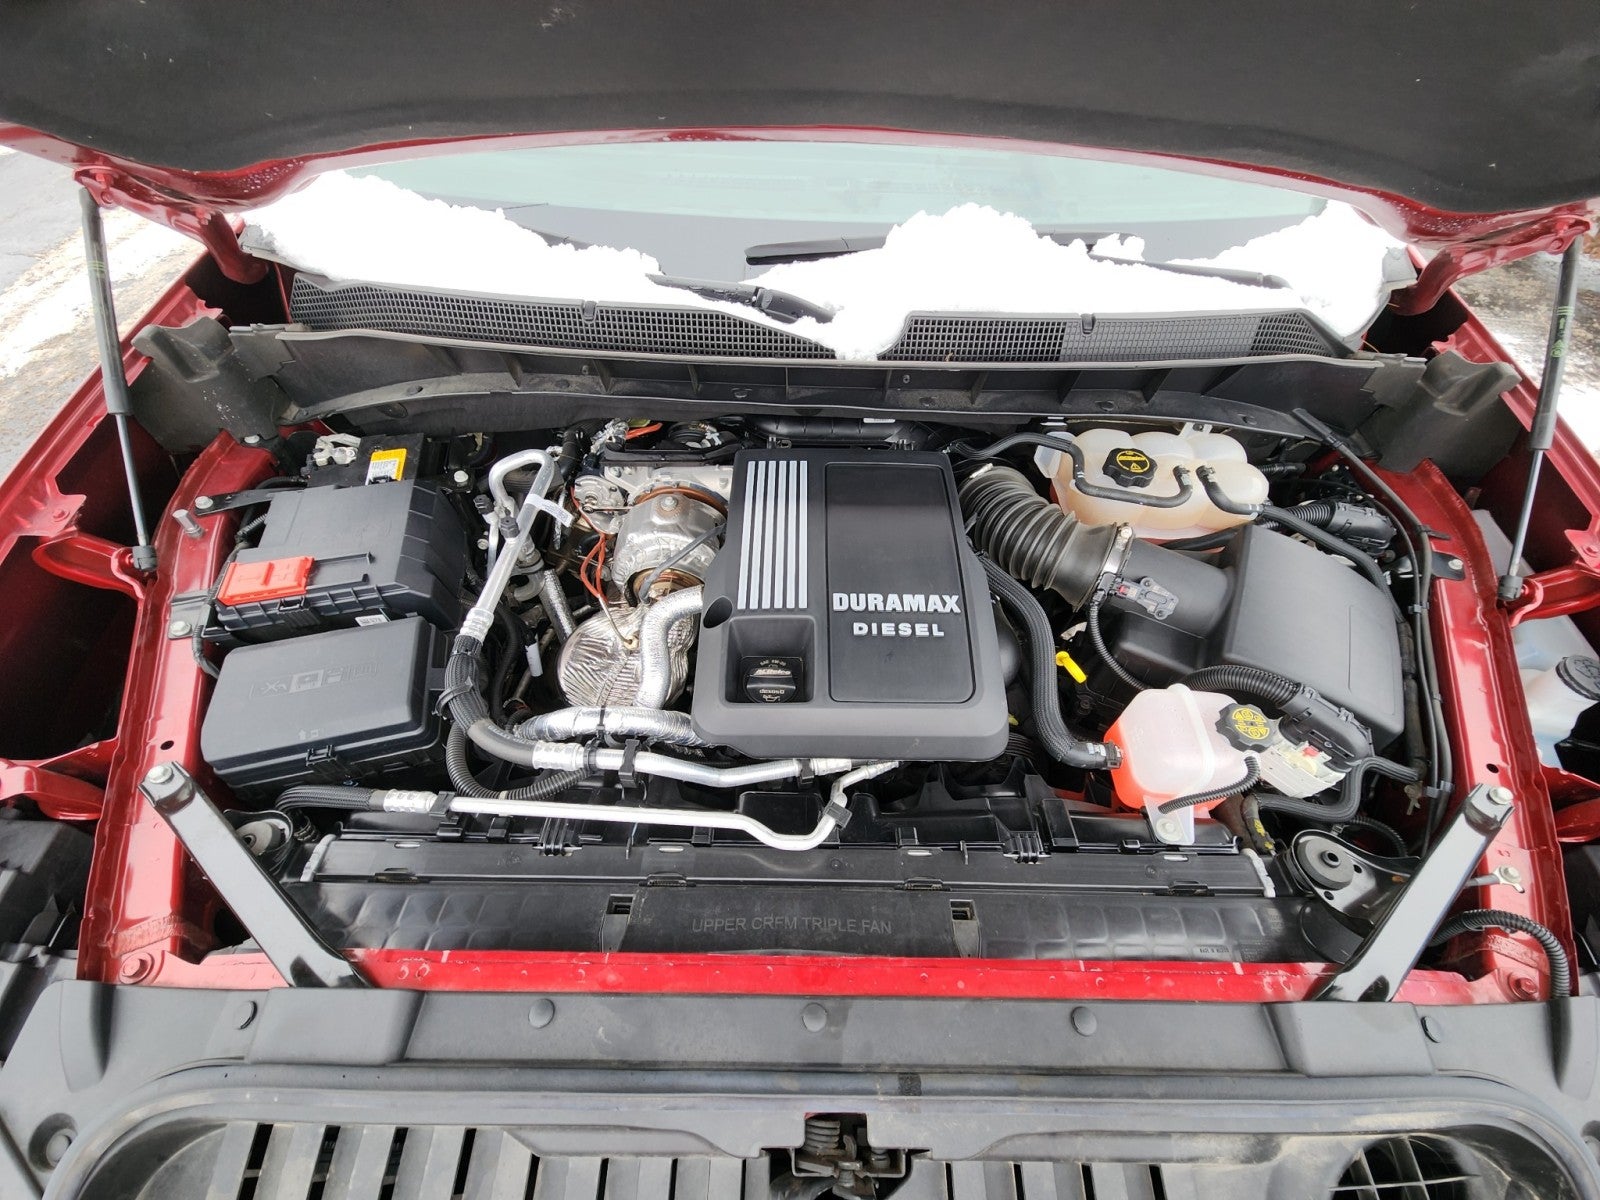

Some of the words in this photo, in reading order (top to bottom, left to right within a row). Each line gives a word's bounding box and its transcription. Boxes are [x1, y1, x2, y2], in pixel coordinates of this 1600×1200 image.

[832, 592, 961, 613] DURAMAX
[853, 622, 945, 637] DIESEL
[692, 917, 746, 932] UPPER
[752, 915, 797, 930] CRFM
[802, 917, 857, 932] TRIPLE
[862, 919, 892, 934] FAN
